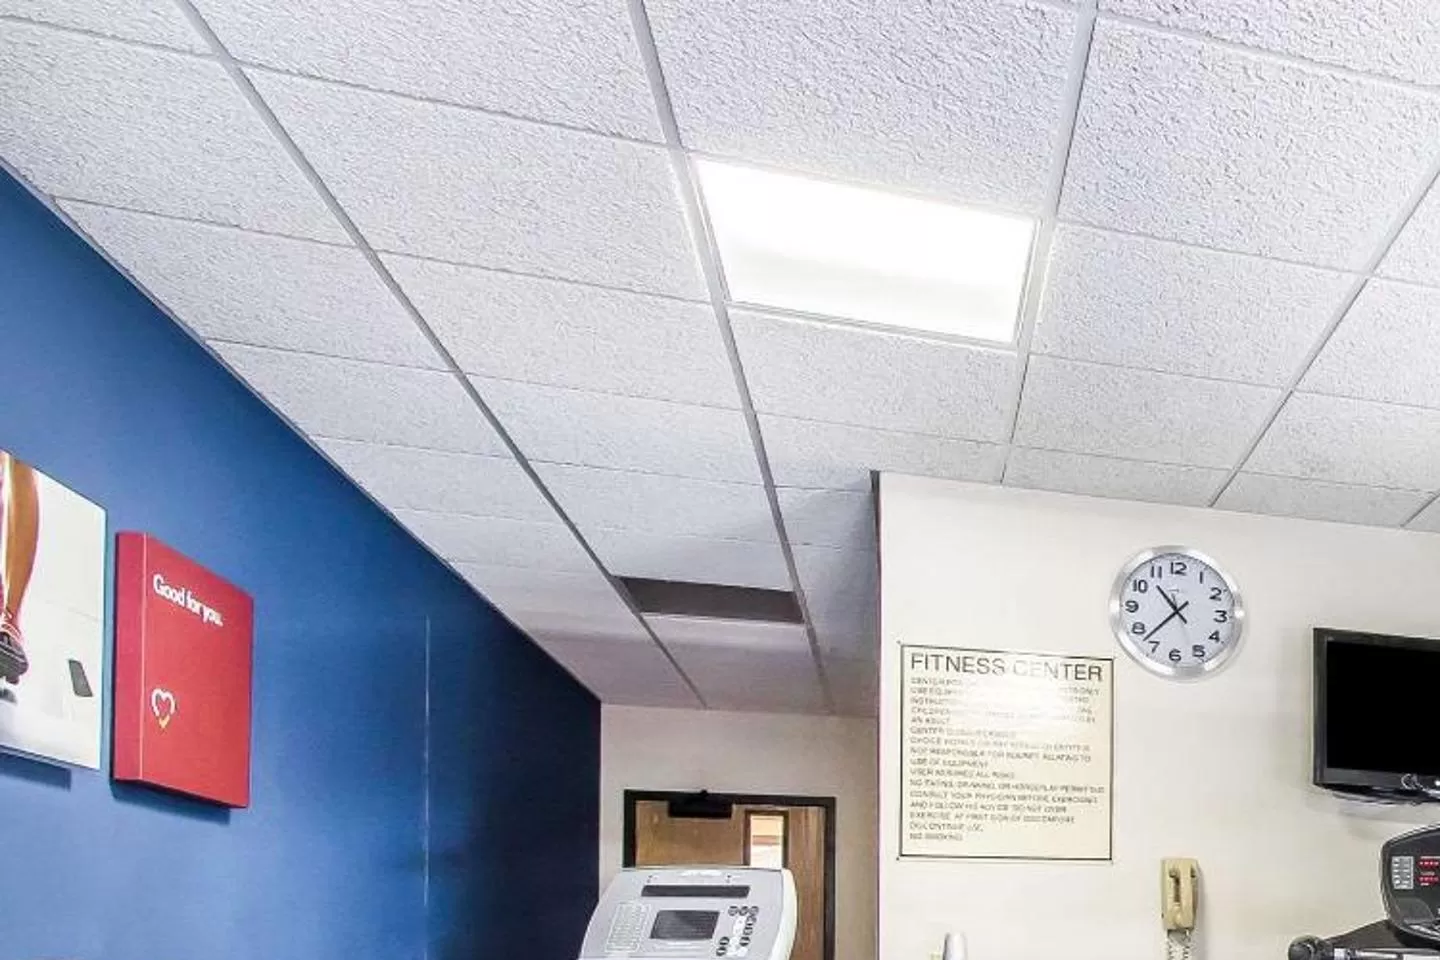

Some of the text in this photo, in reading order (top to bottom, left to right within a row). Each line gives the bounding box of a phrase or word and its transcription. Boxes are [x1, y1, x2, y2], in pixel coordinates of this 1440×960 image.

[1150, 565, 1162, 579] 11
[1170, 561, 1187, 576] 12
[1198, 571, 1204, 584] 1
[1132, 579, 1148, 593] 10
[152, 573, 186, 608] Good
[186, 589, 201, 617] for
[1209, 587, 1222, 601] 2
[1125, 600, 1139, 613] 9
[1213, 610, 1228, 623] 3
[1131, 622, 1146, 635] 8
[1208, 630, 1220, 643] 4
[1148, 641, 1160, 653] 7
[1192, 645, 1205, 658] 5
[1168, 649, 1182, 662] 6
[911, 653, 1103, 682] FITNESS CENTER
